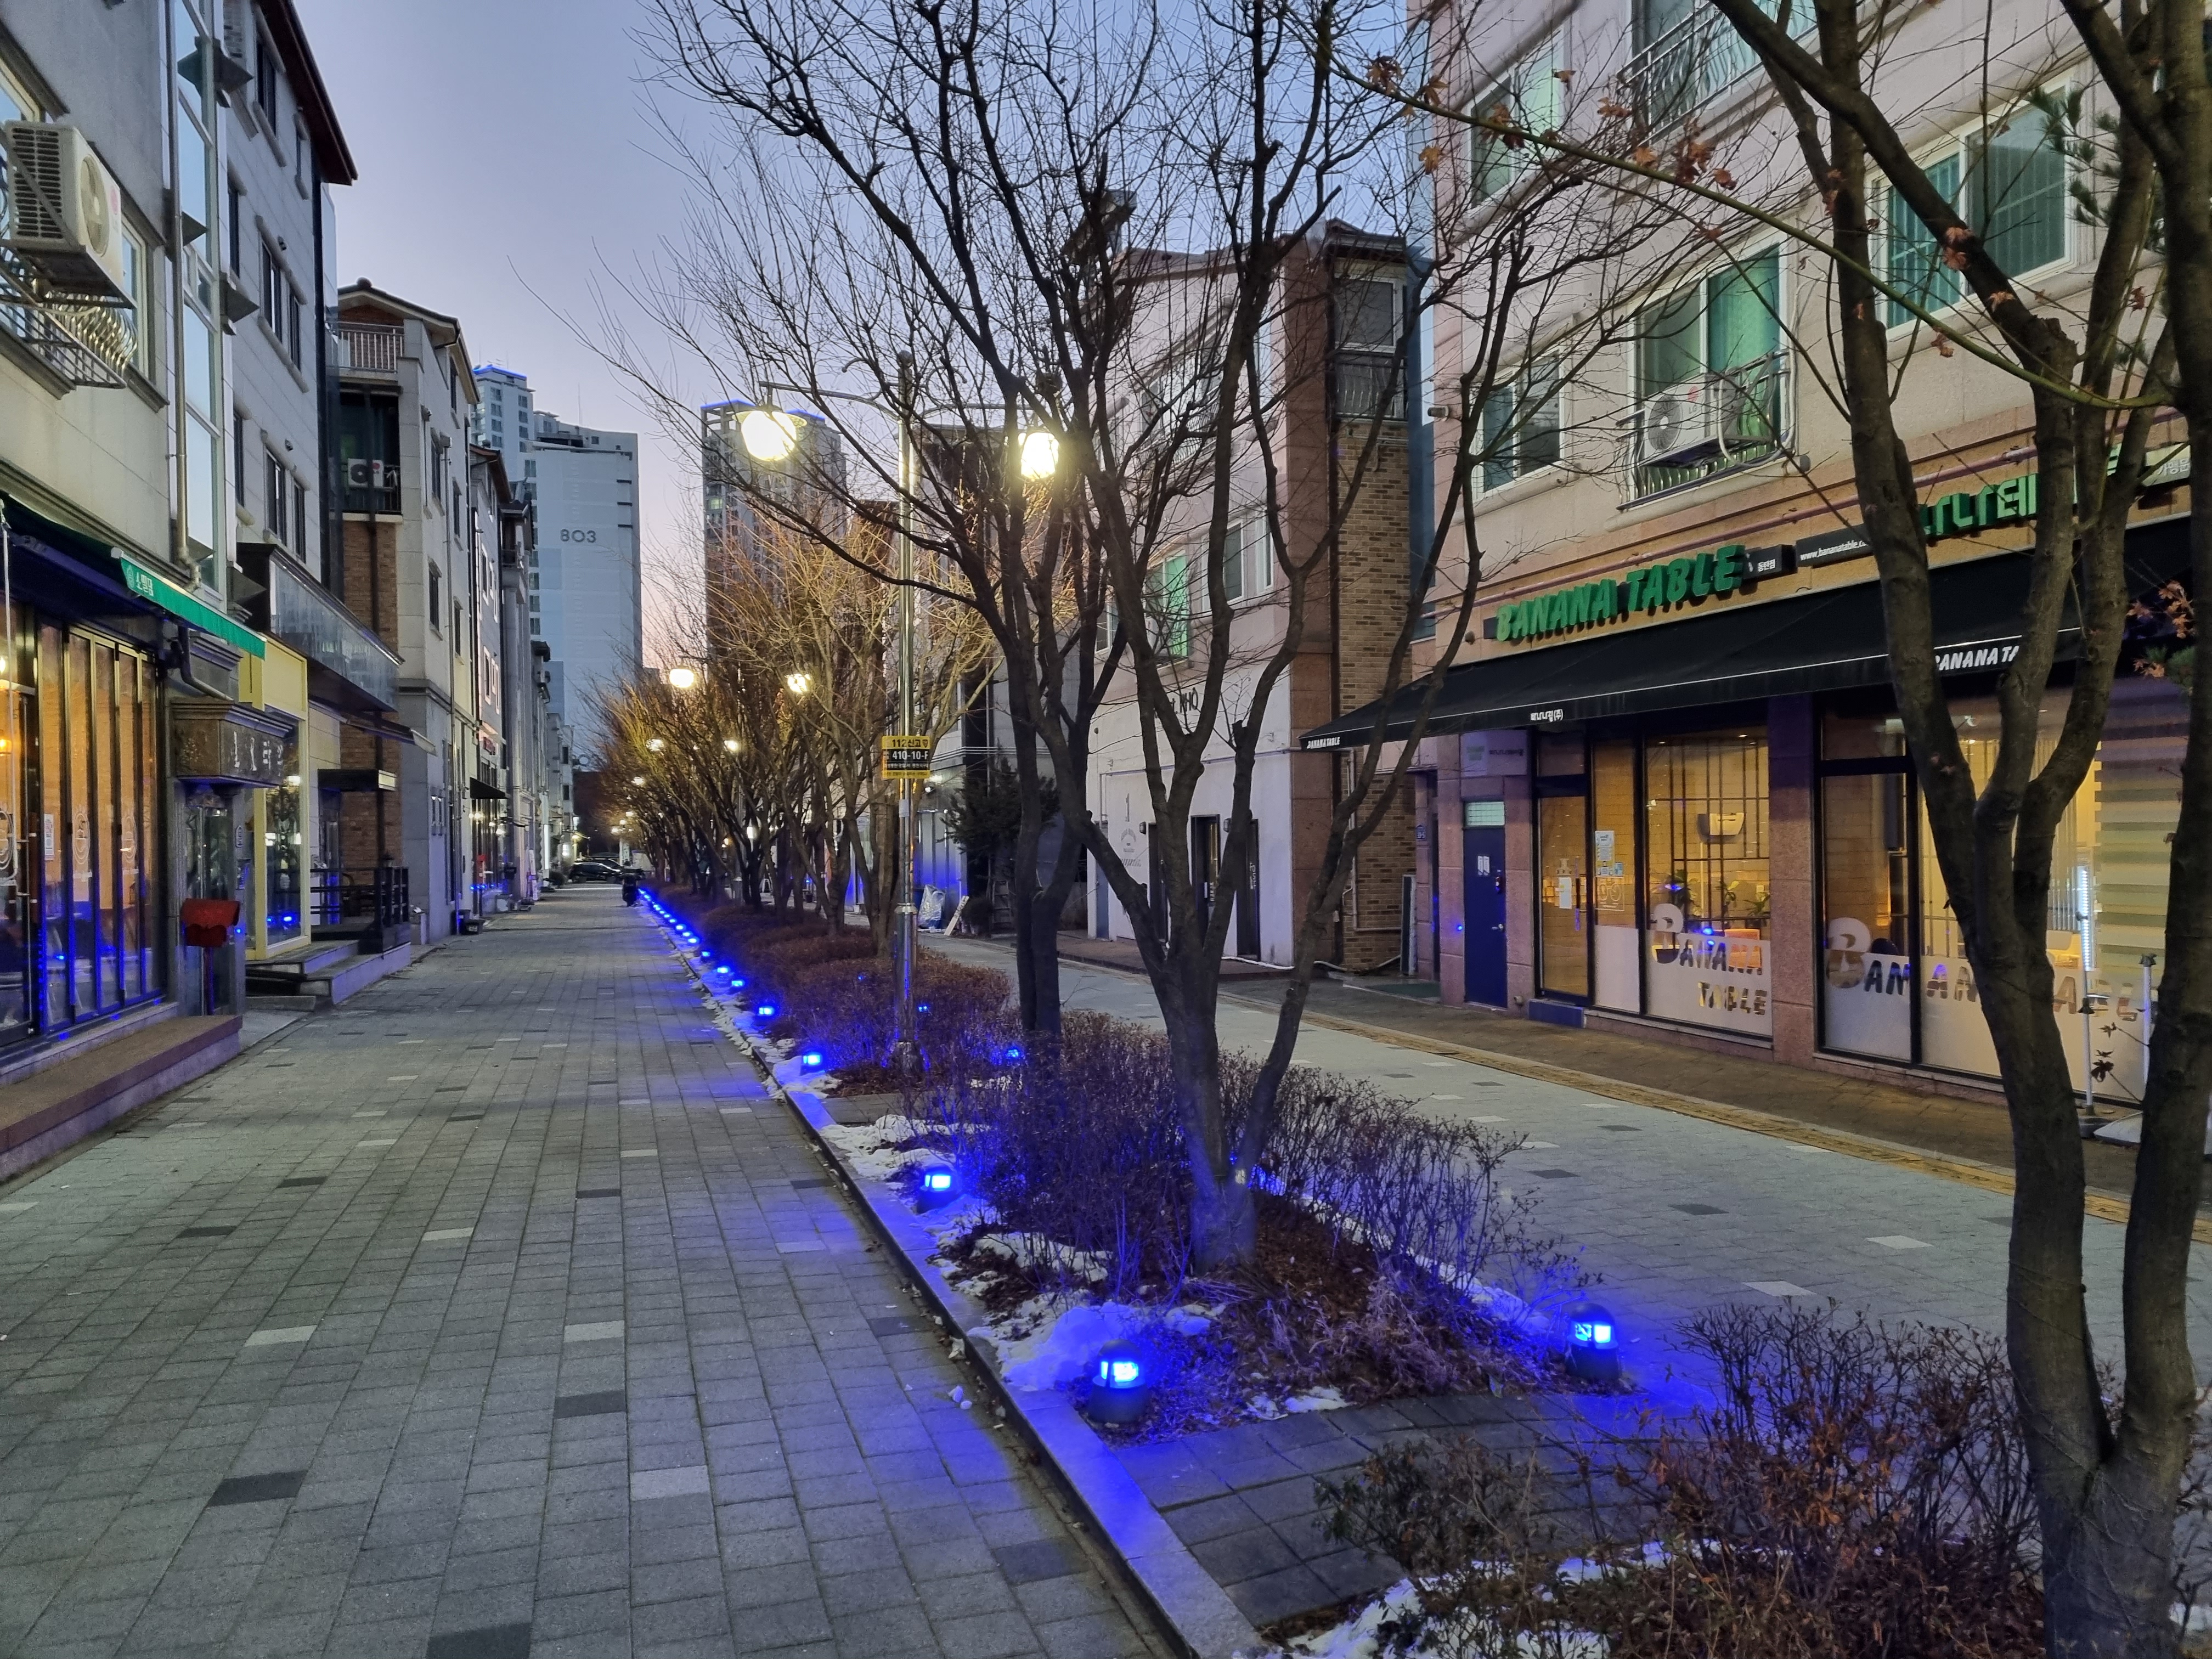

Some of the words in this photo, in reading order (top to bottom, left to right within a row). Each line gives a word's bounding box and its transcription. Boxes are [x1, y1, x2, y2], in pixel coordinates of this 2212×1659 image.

[560, 529, 596, 543] 803
[1758, 558, 1776, 572] 동탄점
[1496, 578, 1618, 642] BANANA
[1627, 544, 1746, 612] TABLE
[892, 739, 921, 747] 112신고
[1306, 738, 1327, 749] BANANA
[1326, 736, 1341, 747] TABLE
[1651, 903, 1763, 976] BANANA
[1697, 980, 1768, 1015] TABLE
